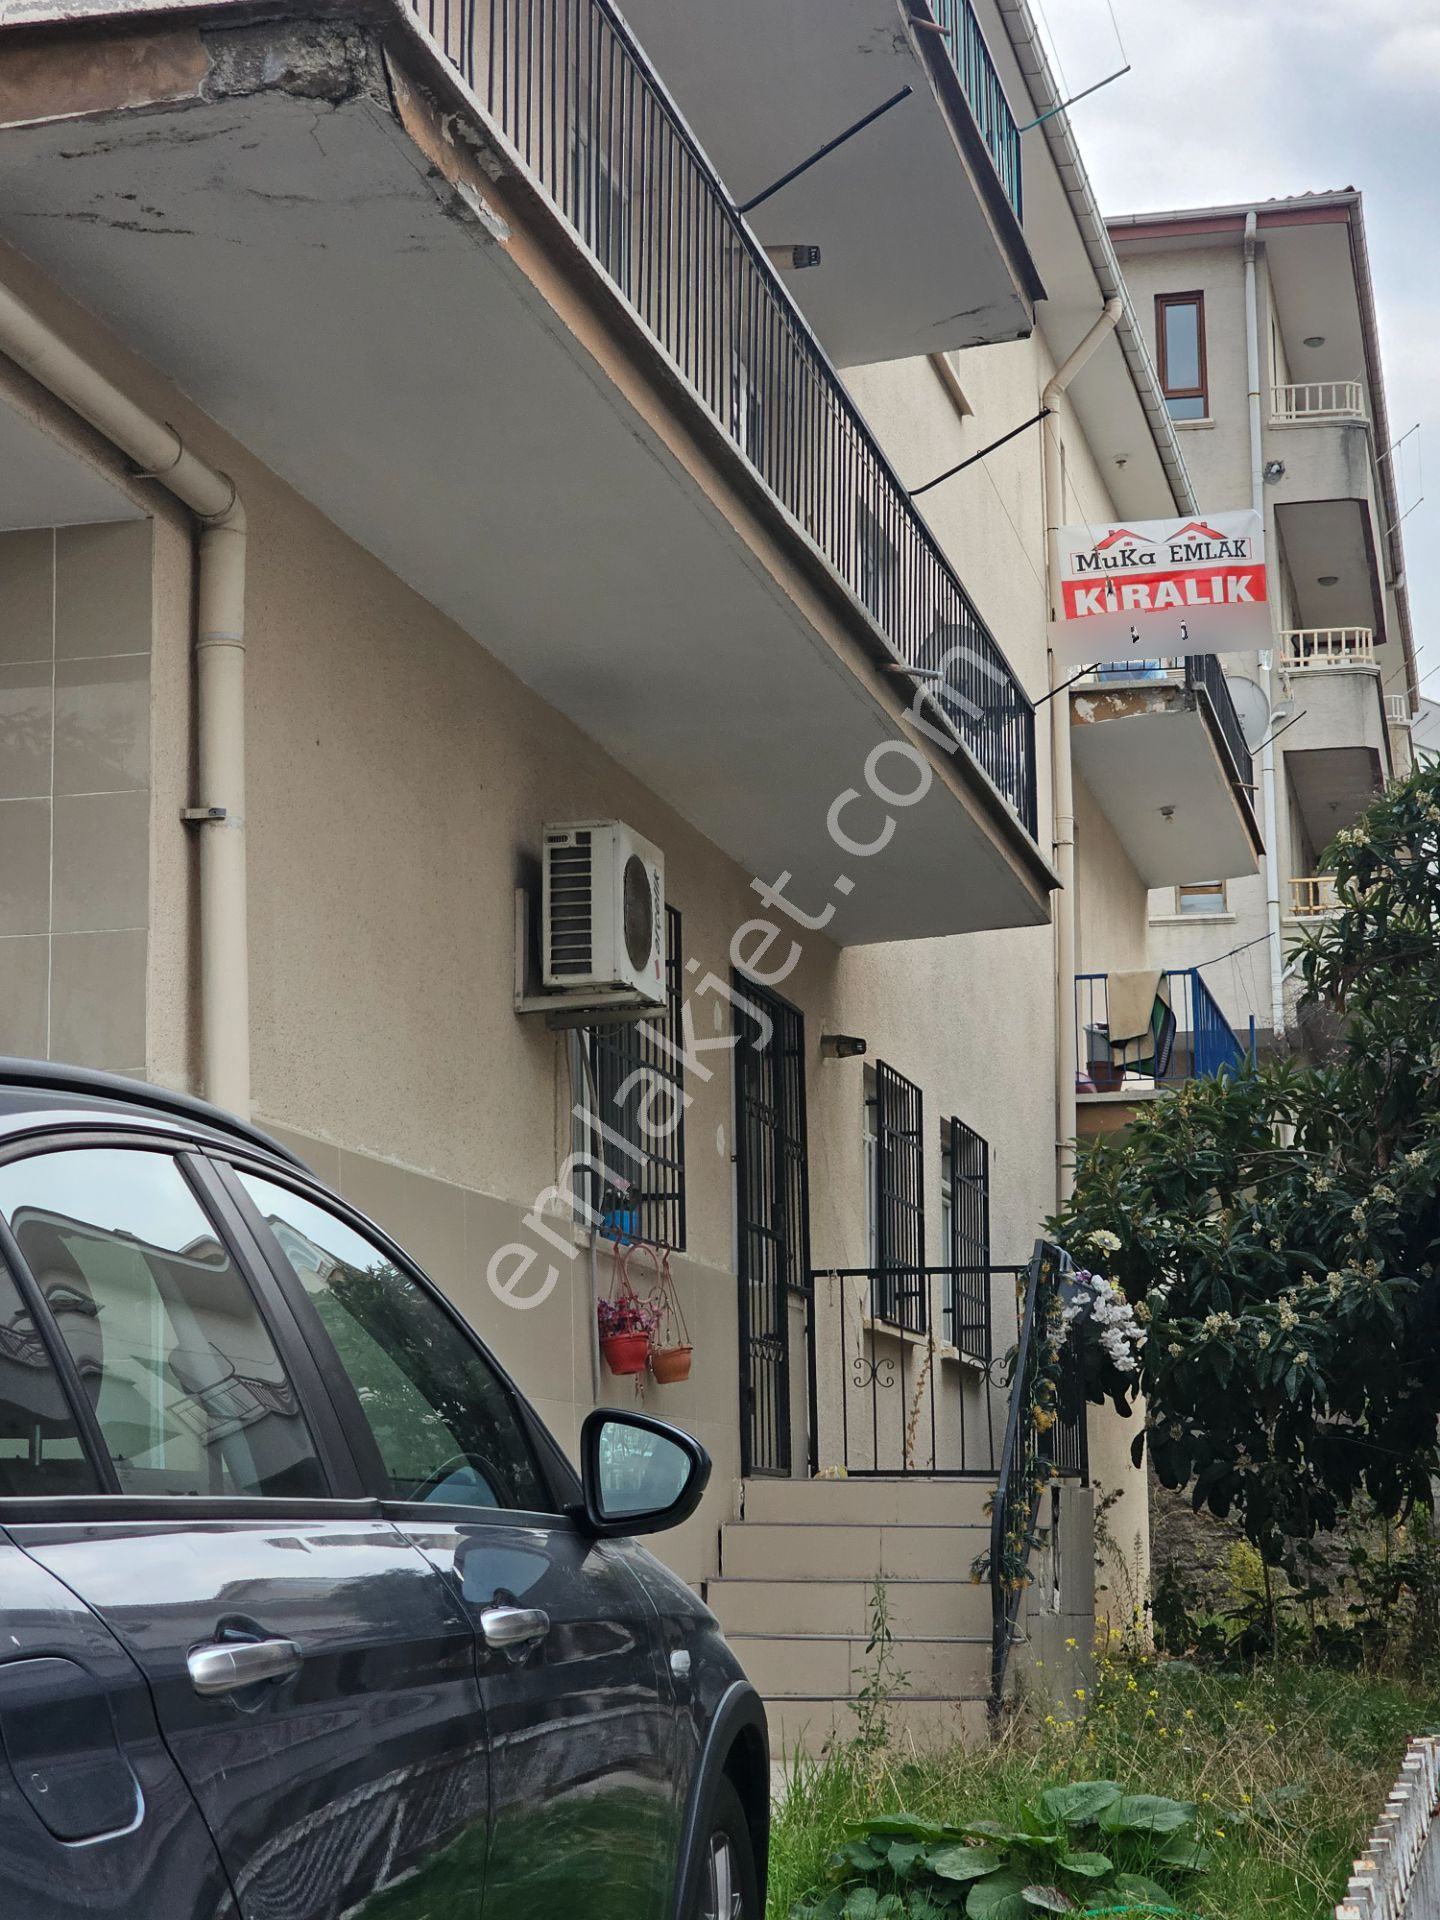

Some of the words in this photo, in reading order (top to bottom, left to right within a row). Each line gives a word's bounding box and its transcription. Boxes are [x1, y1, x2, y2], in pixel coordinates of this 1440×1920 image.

[1075, 548, 1157, 572] MuKa
[1169, 539, 1248, 563] EMLAK
[1073, 574, 1255, 617] KİRALIK
